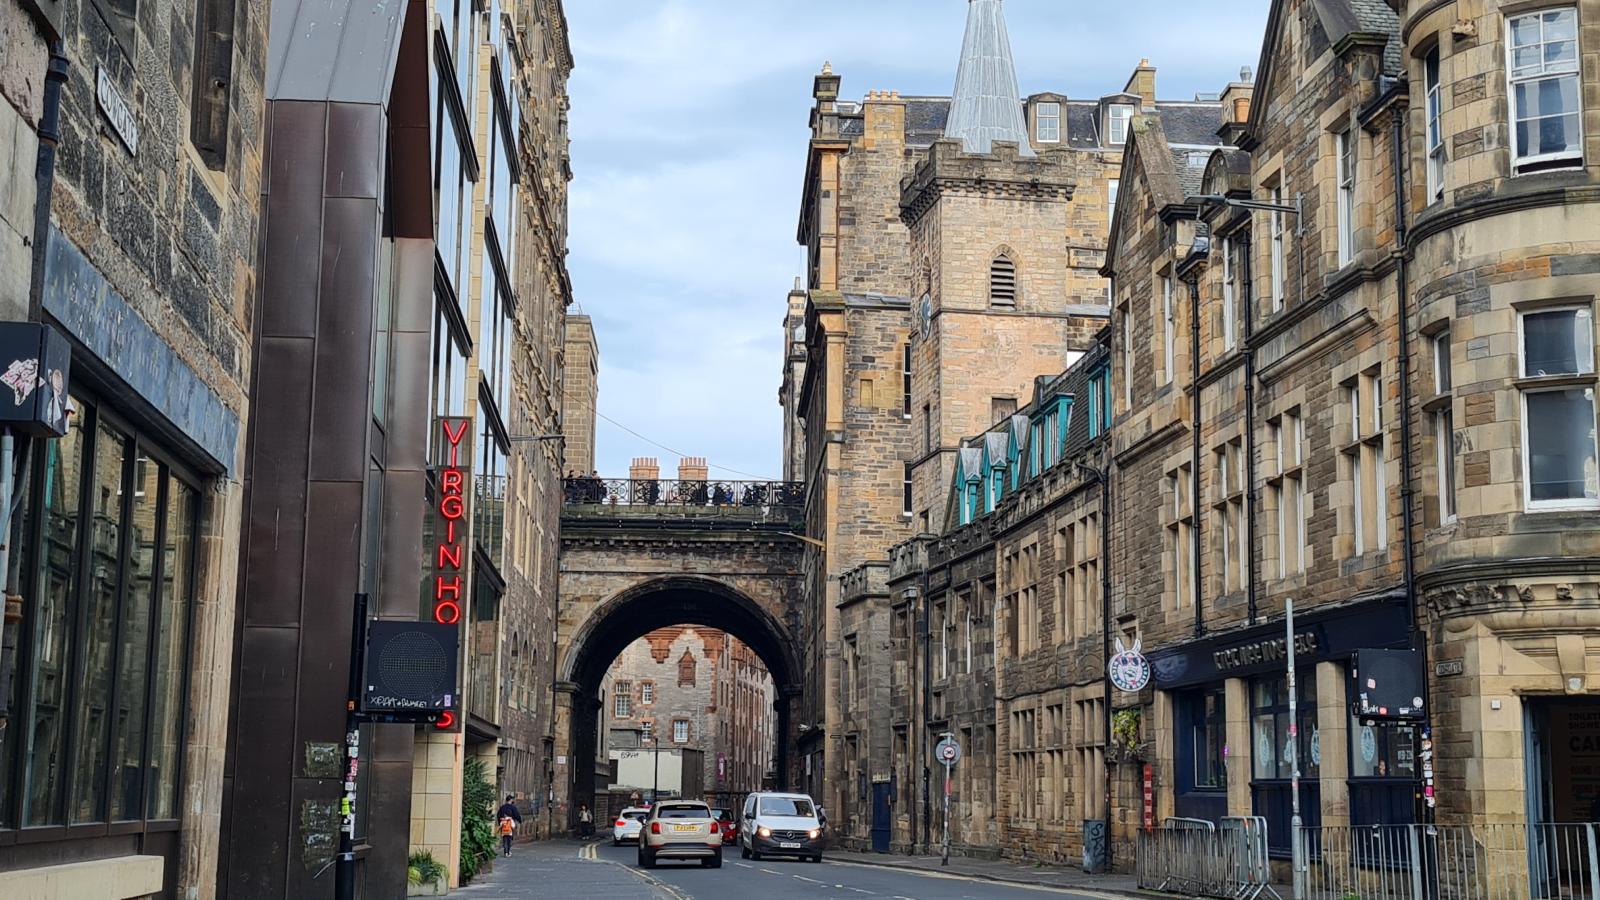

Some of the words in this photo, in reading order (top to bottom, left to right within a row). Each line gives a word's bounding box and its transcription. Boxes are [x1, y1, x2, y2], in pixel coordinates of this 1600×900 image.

[101, 77, 137, 149] COWGATE
[440, 420, 468, 569] VIRGIN
[1260, 631, 1318, 662] HOSELS
[1567, 721, 1600, 730] SHOWE
[1568, 712, 1600, 721] TOILET
